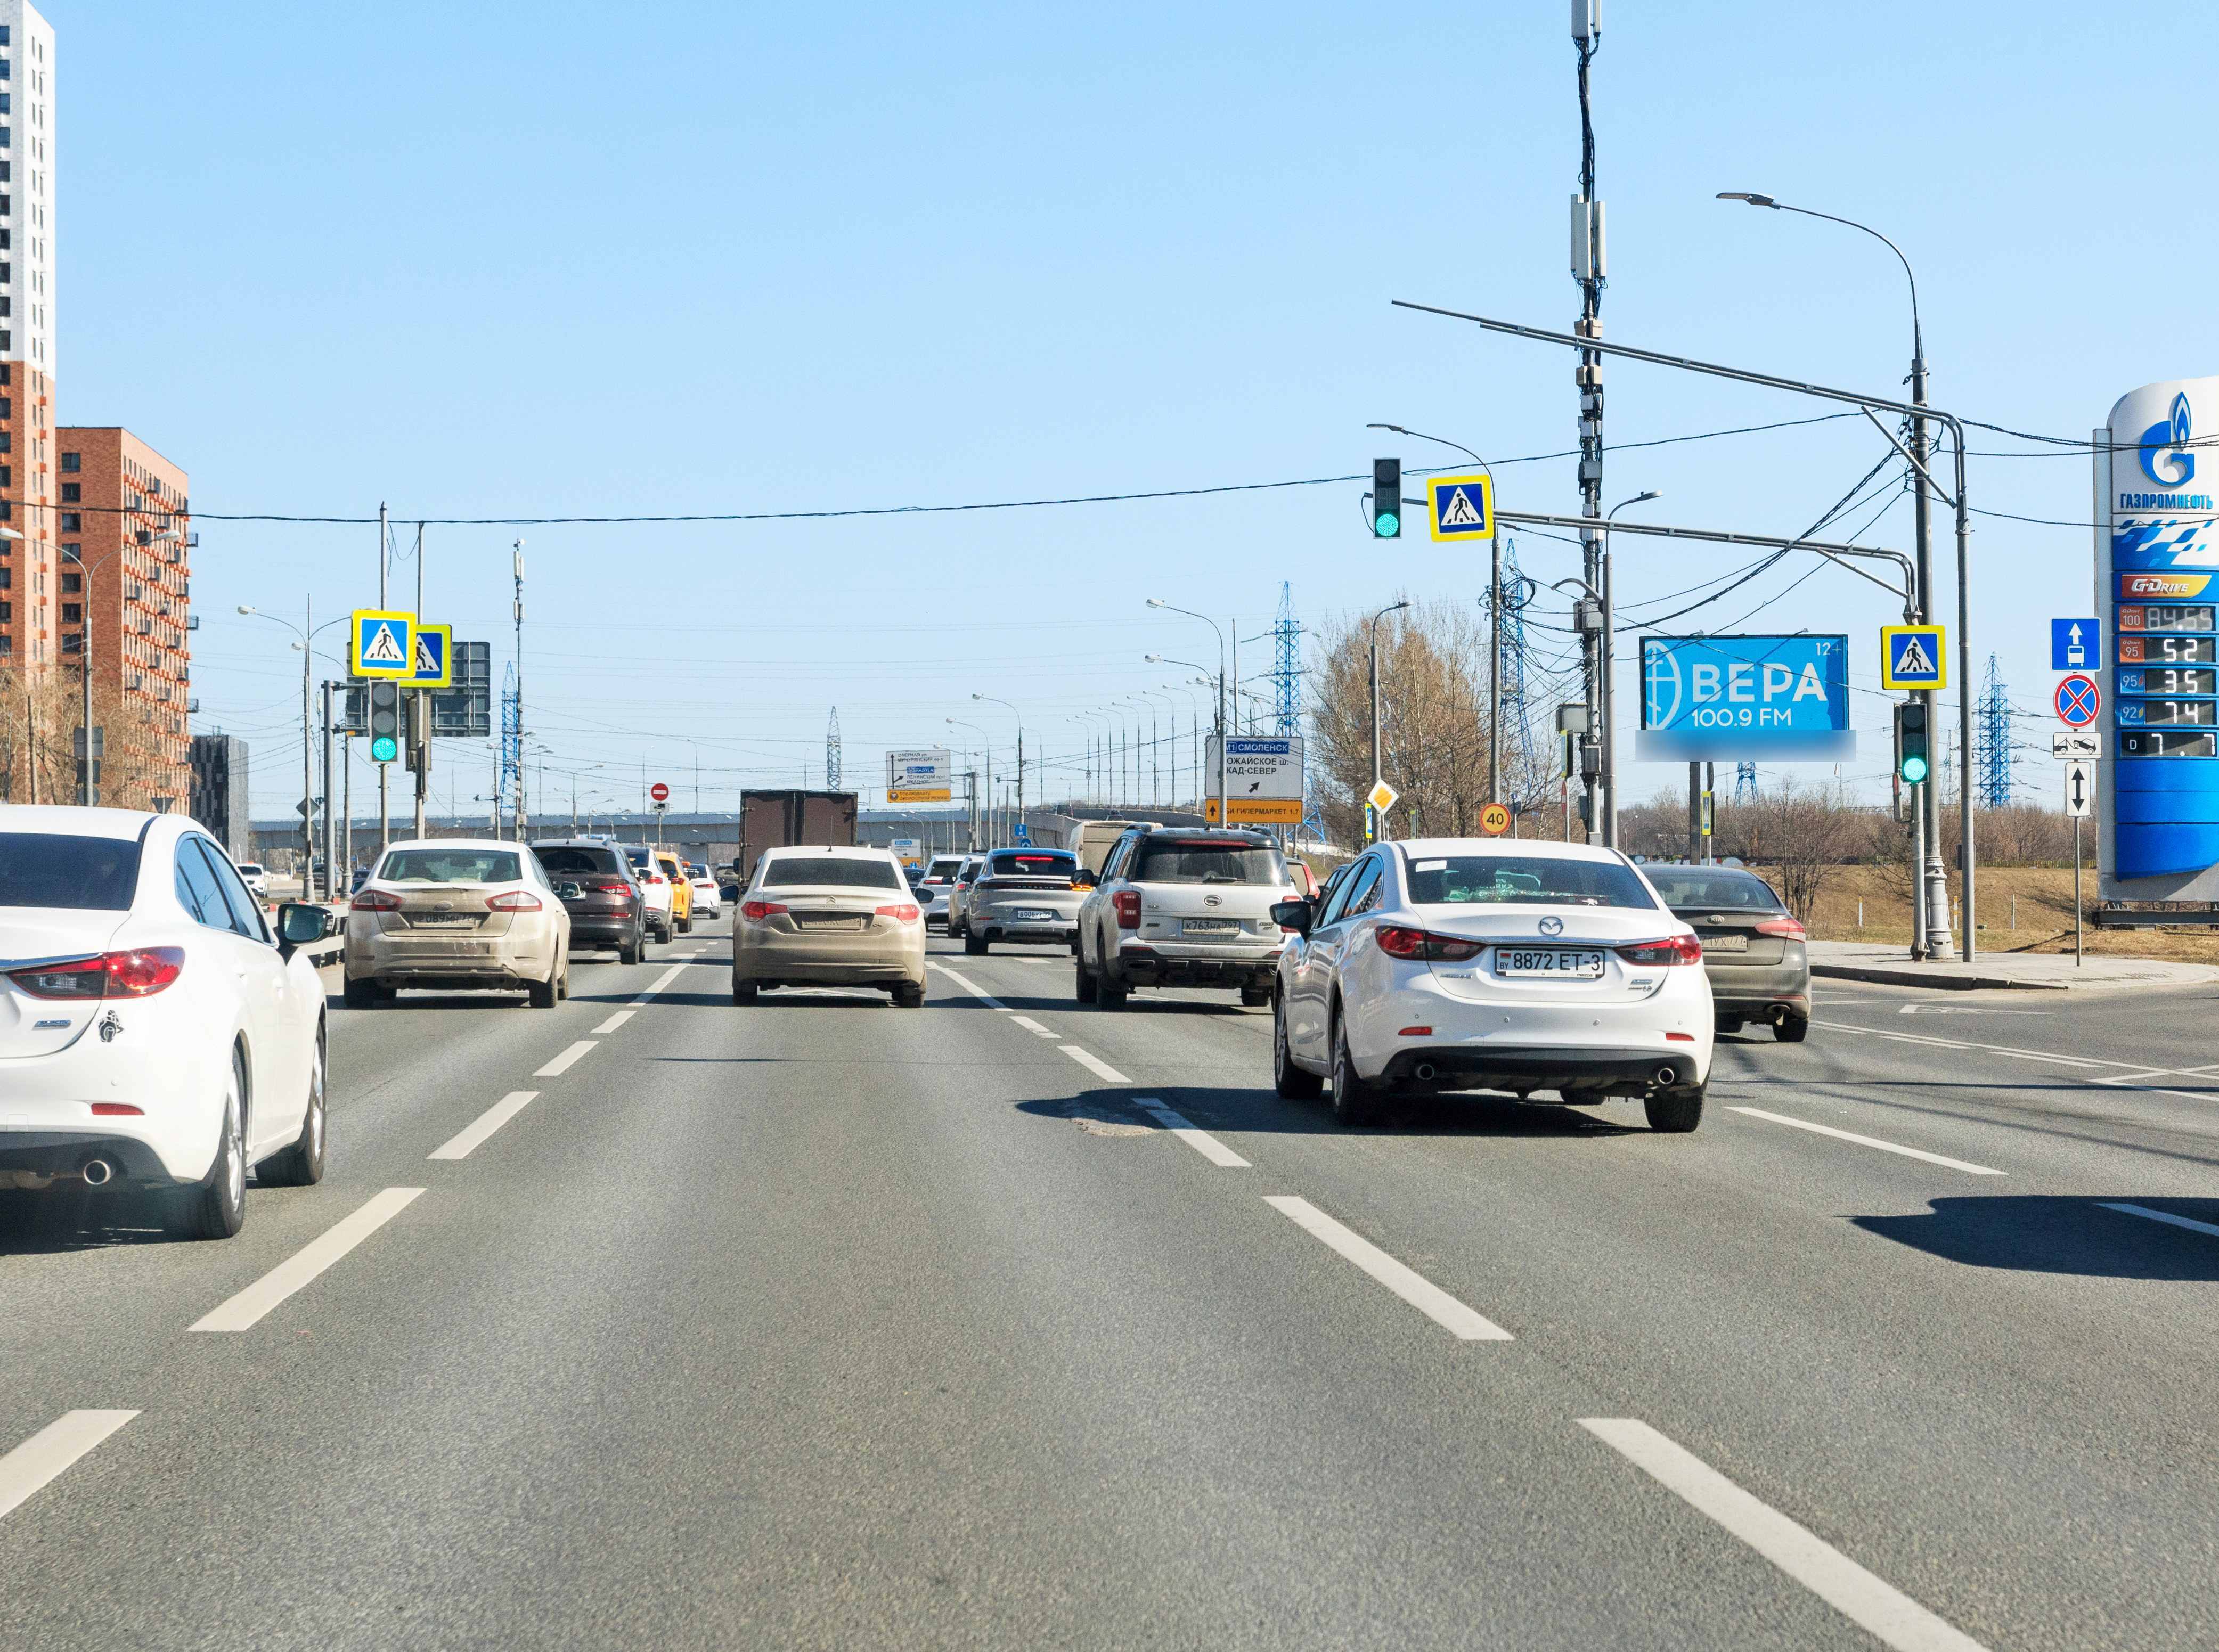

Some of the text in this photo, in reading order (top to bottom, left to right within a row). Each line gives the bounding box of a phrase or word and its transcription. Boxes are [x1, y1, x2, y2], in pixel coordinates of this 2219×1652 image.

[2120, 494, 2213, 509] ГАЗПРОМНЕФТЬ
[2123, 615, 2140, 625] 100
[1816, 642, 1842, 657] 12+
[2125, 639, 2198, 663] 95 52
[1692, 662, 1828, 702] ВЕРА
[2123, 670, 2198, 693] 95 35
[1692, 708, 1792, 727] 100.9 FM
[2123, 702, 2199, 724] 92 74
[1238, 743, 1288, 752] СМОЛЕНСК
[2130, 739, 2137, 750] D
[1227, 756, 1277, 765] ОЖАЙСКОЕ
[1227, 767, 1277, 776] КАД-СЕВЕР
[1486, 813, 1505, 825] 40
[1513, 952, 1553, 970] 8872
[1560, 953, 1601, 971] ET-3
